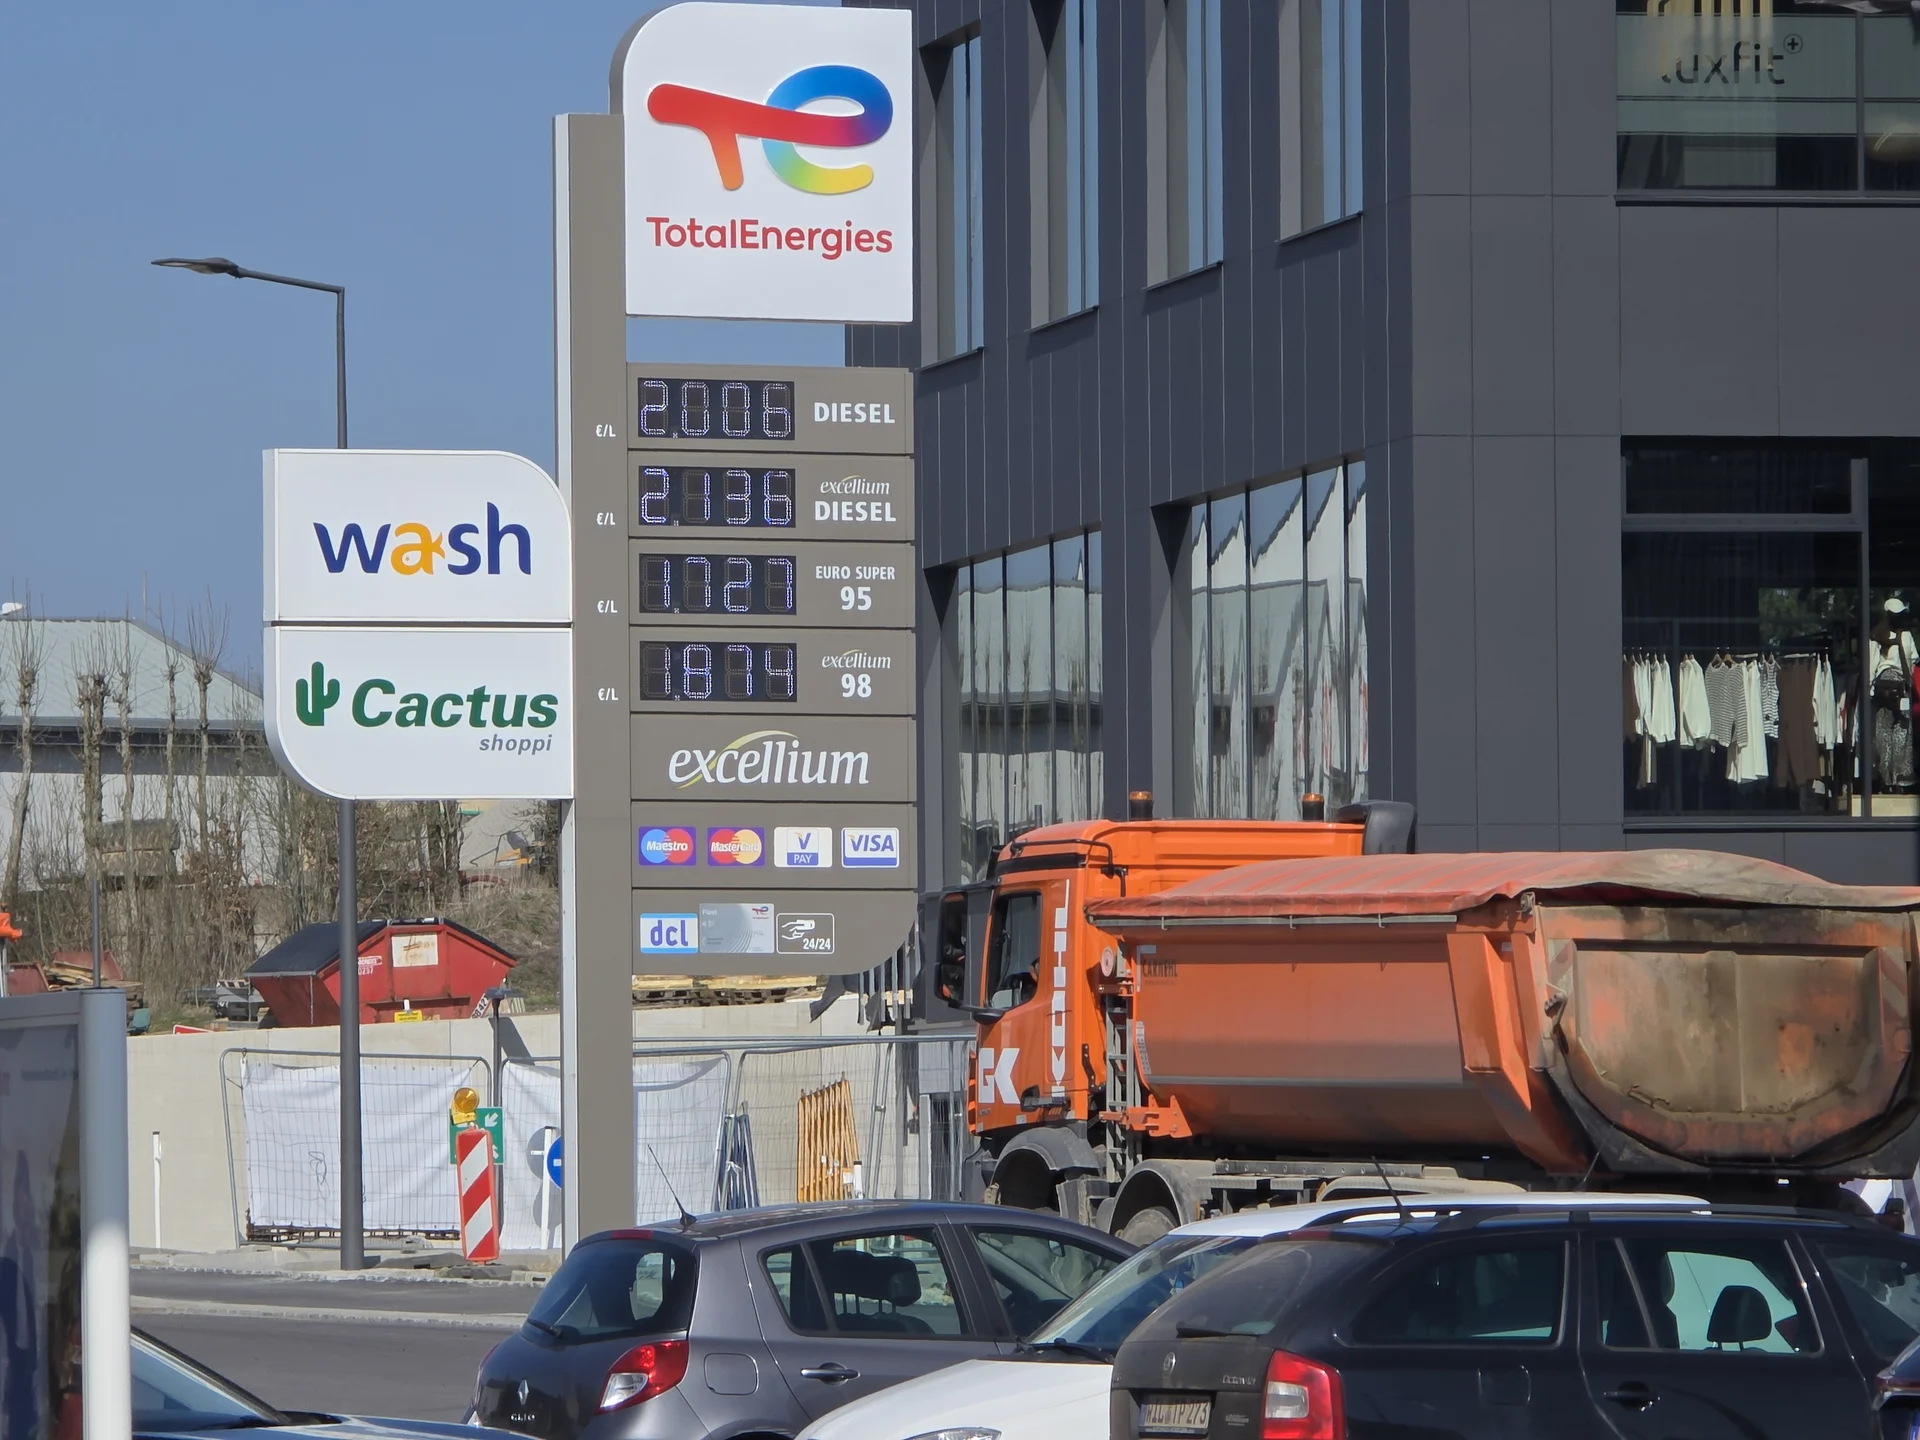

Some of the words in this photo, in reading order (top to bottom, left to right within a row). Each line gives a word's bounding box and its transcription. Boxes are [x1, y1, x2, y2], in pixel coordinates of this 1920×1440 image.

[646, 217, 893, 260] TotalEnergies
[814, 402, 895, 423] DIESEL
[595, 424, 616, 438] €/L
[820, 478, 890, 495] excellium
[596, 512, 616, 526] €/L
[815, 501, 897, 522] DIESEL
[313, 501, 531, 575] wash
[815, 566, 851, 579] EURO
[855, 566, 895, 580] SUPER
[840, 586, 872, 610] 95
[597, 600, 618, 614] €/L
[821, 652, 891, 669] excellium
[841, 673, 872, 698] 98
[351, 678, 559, 728] Cactus
[598, 688, 619, 702] €/L
[478, 734, 552, 755] shoppi
[668, 739, 869, 785] excellium
[646, 841, 689, 851] Maestro
[710, 841, 760, 852] MasterCard
[797, 833, 811, 850] V
[850, 834, 894, 852] VISA
[793, 853, 812, 863] PAY
[650, 920, 689, 947] dcl
[803, 938, 831, 950] 24/24
[979, 1047, 1021, 1104] GK
